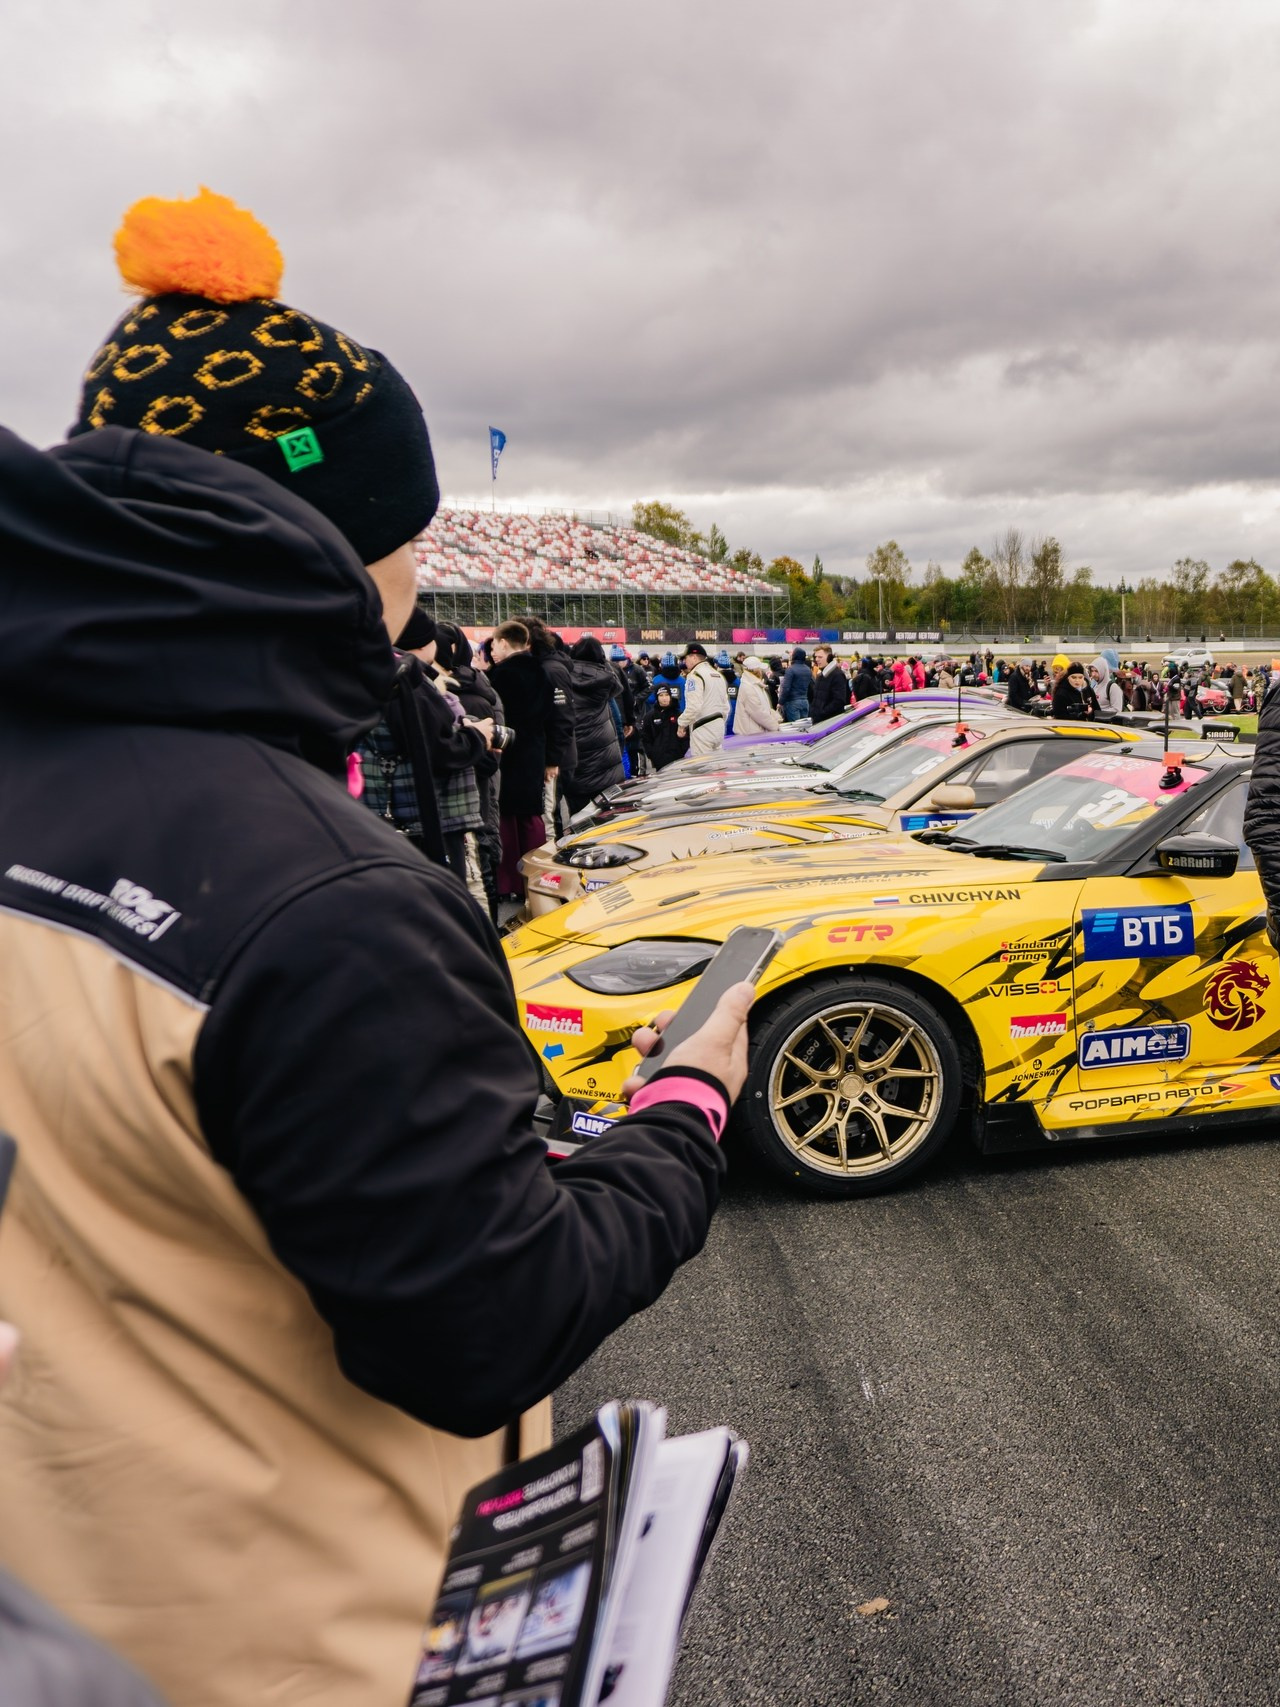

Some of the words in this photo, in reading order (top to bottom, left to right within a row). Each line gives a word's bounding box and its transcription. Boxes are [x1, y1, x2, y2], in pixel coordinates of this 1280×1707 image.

[4, 864, 69, 895] RUSSIAN
[909, 888, 1021, 904] CHIVCHYAN
[827, 924, 893, 944] CTR
[1122, 914, 1184, 948] ВТБ
[1001, 939, 1058, 950] Standard
[1001, 951, 1048, 963] Springs
[989, 981, 1071, 998] VISSOL
[1084, 1033, 1184, 1062] AIMOL
[1012, 1069, 1061, 1082] JONNESWAY
[567, 1087, 617, 1099] JONNESWAY
[1069, 1092, 1161, 1111] ФОРВАРД
[1165, 1086, 1213, 1099] АВТО
